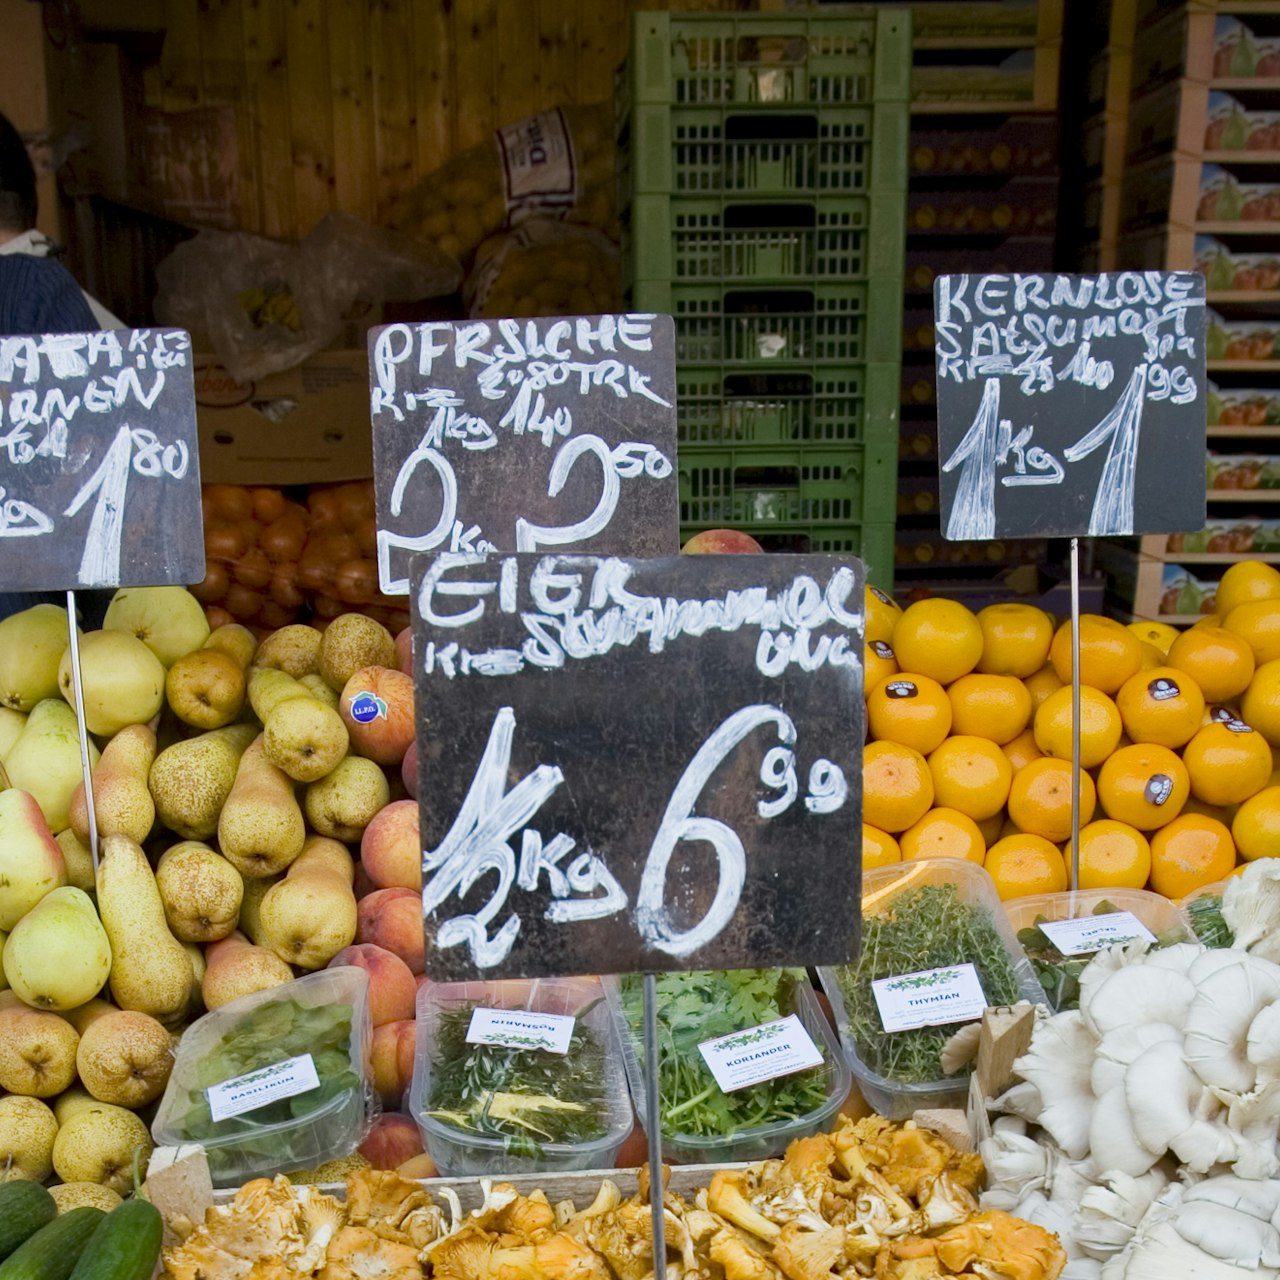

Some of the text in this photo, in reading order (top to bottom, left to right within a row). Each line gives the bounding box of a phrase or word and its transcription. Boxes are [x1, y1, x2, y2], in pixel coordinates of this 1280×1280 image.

[938, 271, 1196, 324] KERNLOSE
[634, 703, 798, 957] 6
[908, 992, 960, 1007] THYMIAN
[491, 1019, 556, 1032] ROSMARIN
[725, 1043, 792, 1068] KORIANDER
[230, 1076, 295, 1101] BASILIKUM
